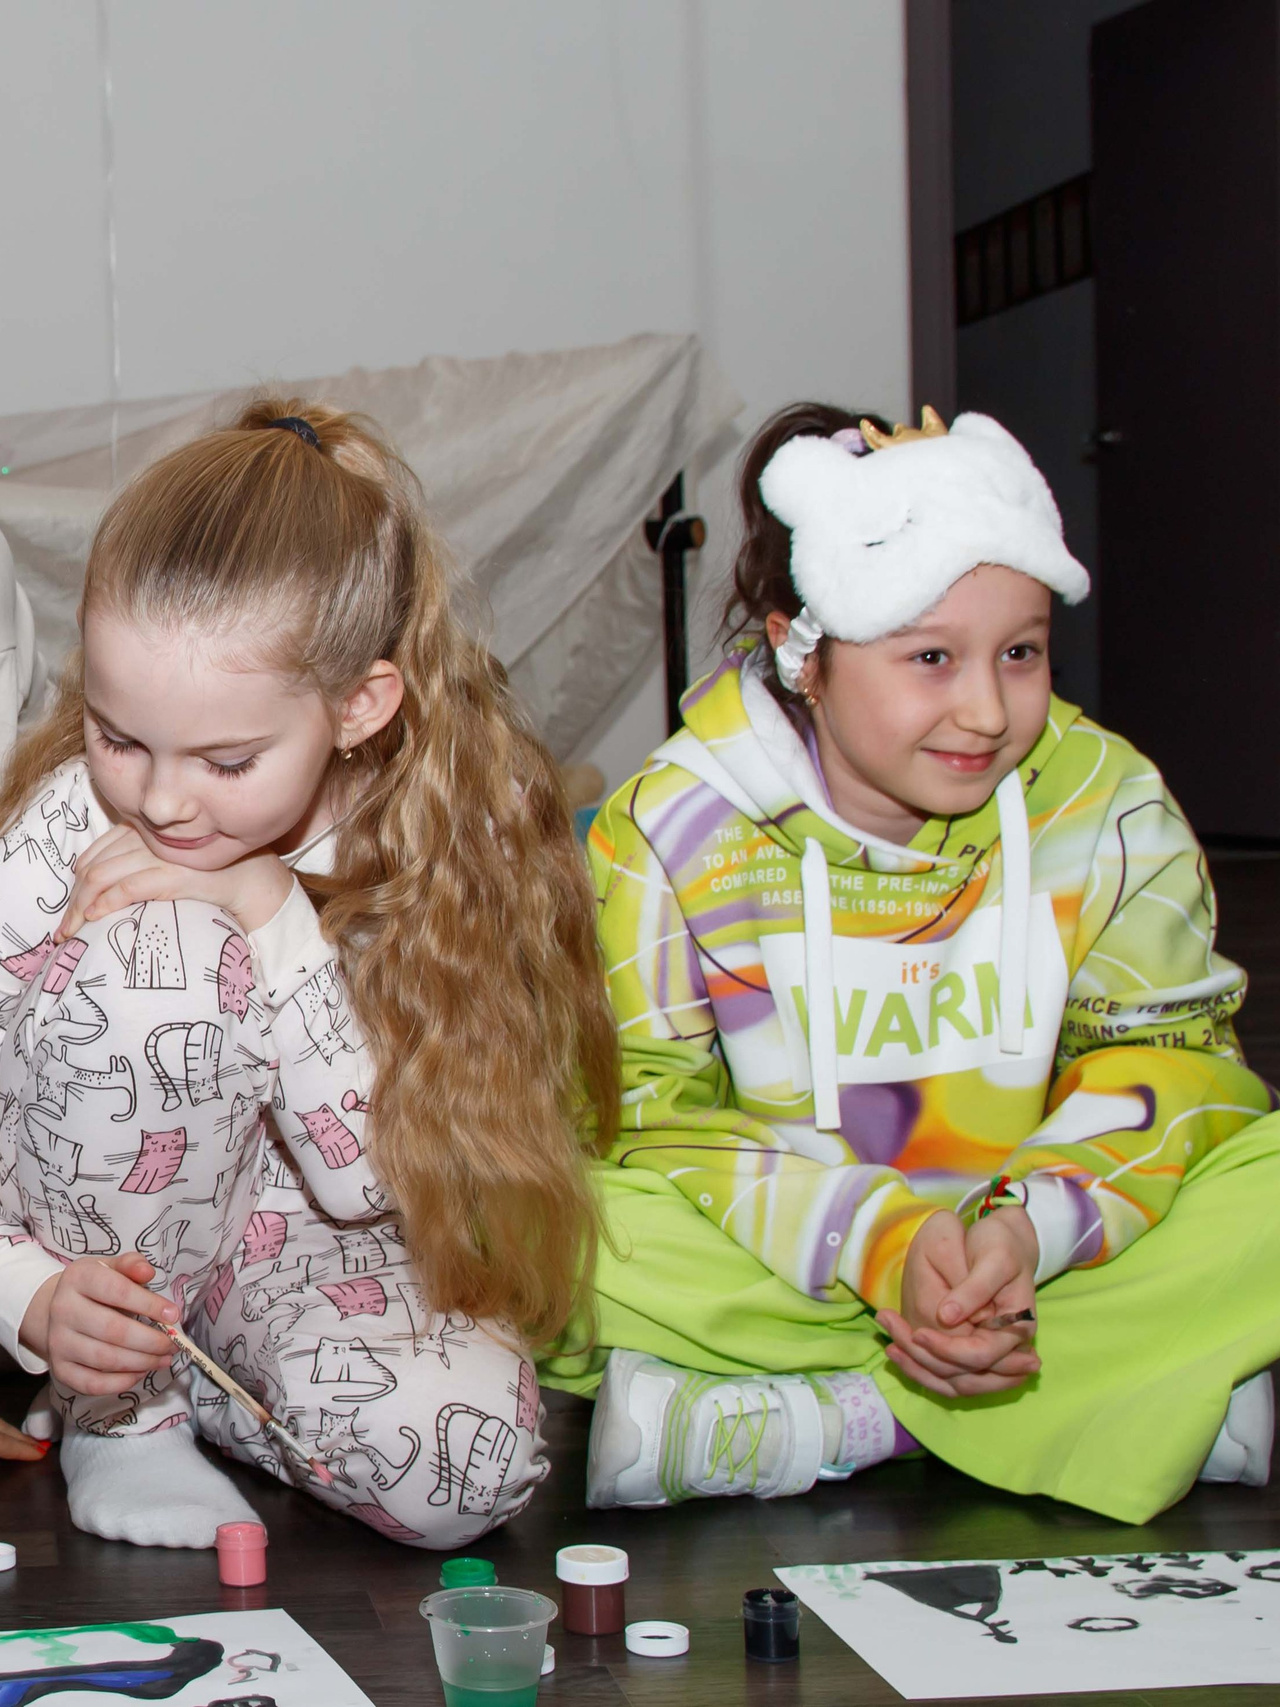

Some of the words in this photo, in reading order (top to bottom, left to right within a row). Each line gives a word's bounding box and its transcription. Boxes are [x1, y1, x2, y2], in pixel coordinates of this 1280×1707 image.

[716, 825, 743, 843] THE
[703, 854, 725, 870] TO
[731, 849, 748, 866] AN
[756, 844, 791, 861] AVE
[710, 867, 787, 893] COMPARED
[830, 875, 864, 891] THE
[901, 961, 940, 984] it's
[790, 961, 1034, 1057] WARM
